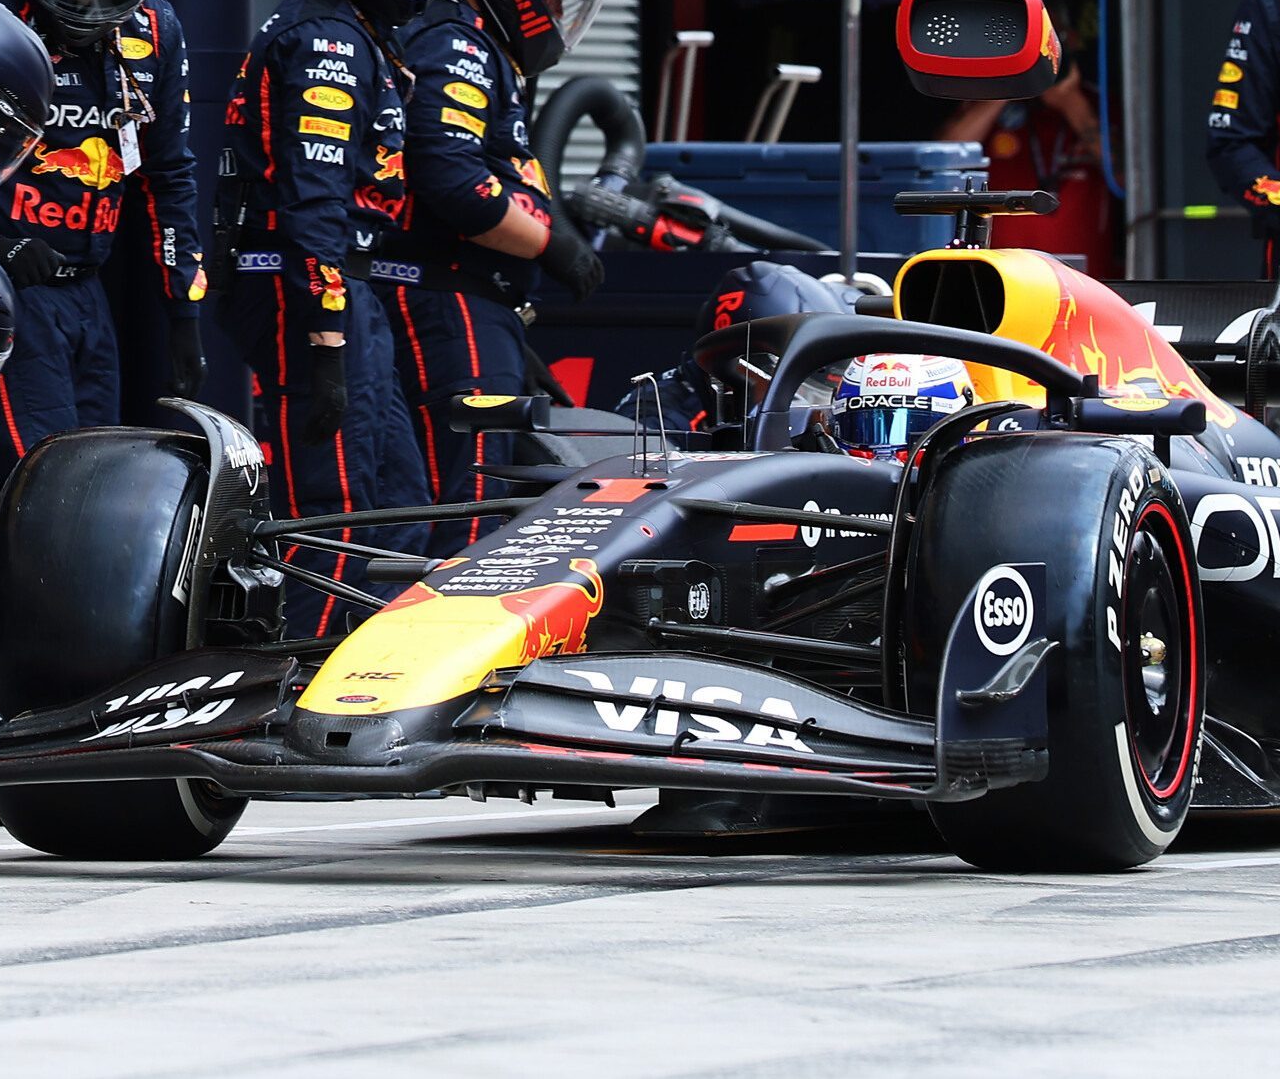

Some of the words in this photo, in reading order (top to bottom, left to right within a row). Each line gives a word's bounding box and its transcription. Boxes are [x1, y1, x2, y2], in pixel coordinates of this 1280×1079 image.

[312, 37, 355, 58] Mobil
[317, 58, 349, 72] AVA
[304, 68, 358, 87] TRADE
[300, 141, 345, 166] VISA
[10, 182, 92, 230] Red
[865, 376, 887, 388] Red
[888, 376, 912, 388] Bull
[848, 395, 930, 410] ORACLE
[552, 507, 624, 517] VISA
[1108, 464, 1145, 600] ZERO
[437, 583, 502, 592] Mobil
[982, 589, 1023, 628] Esso
[1105, 604, 1122, 653] P
[344, 672, 405, 681] HRC
[564, 668, 815, 753] VISA
